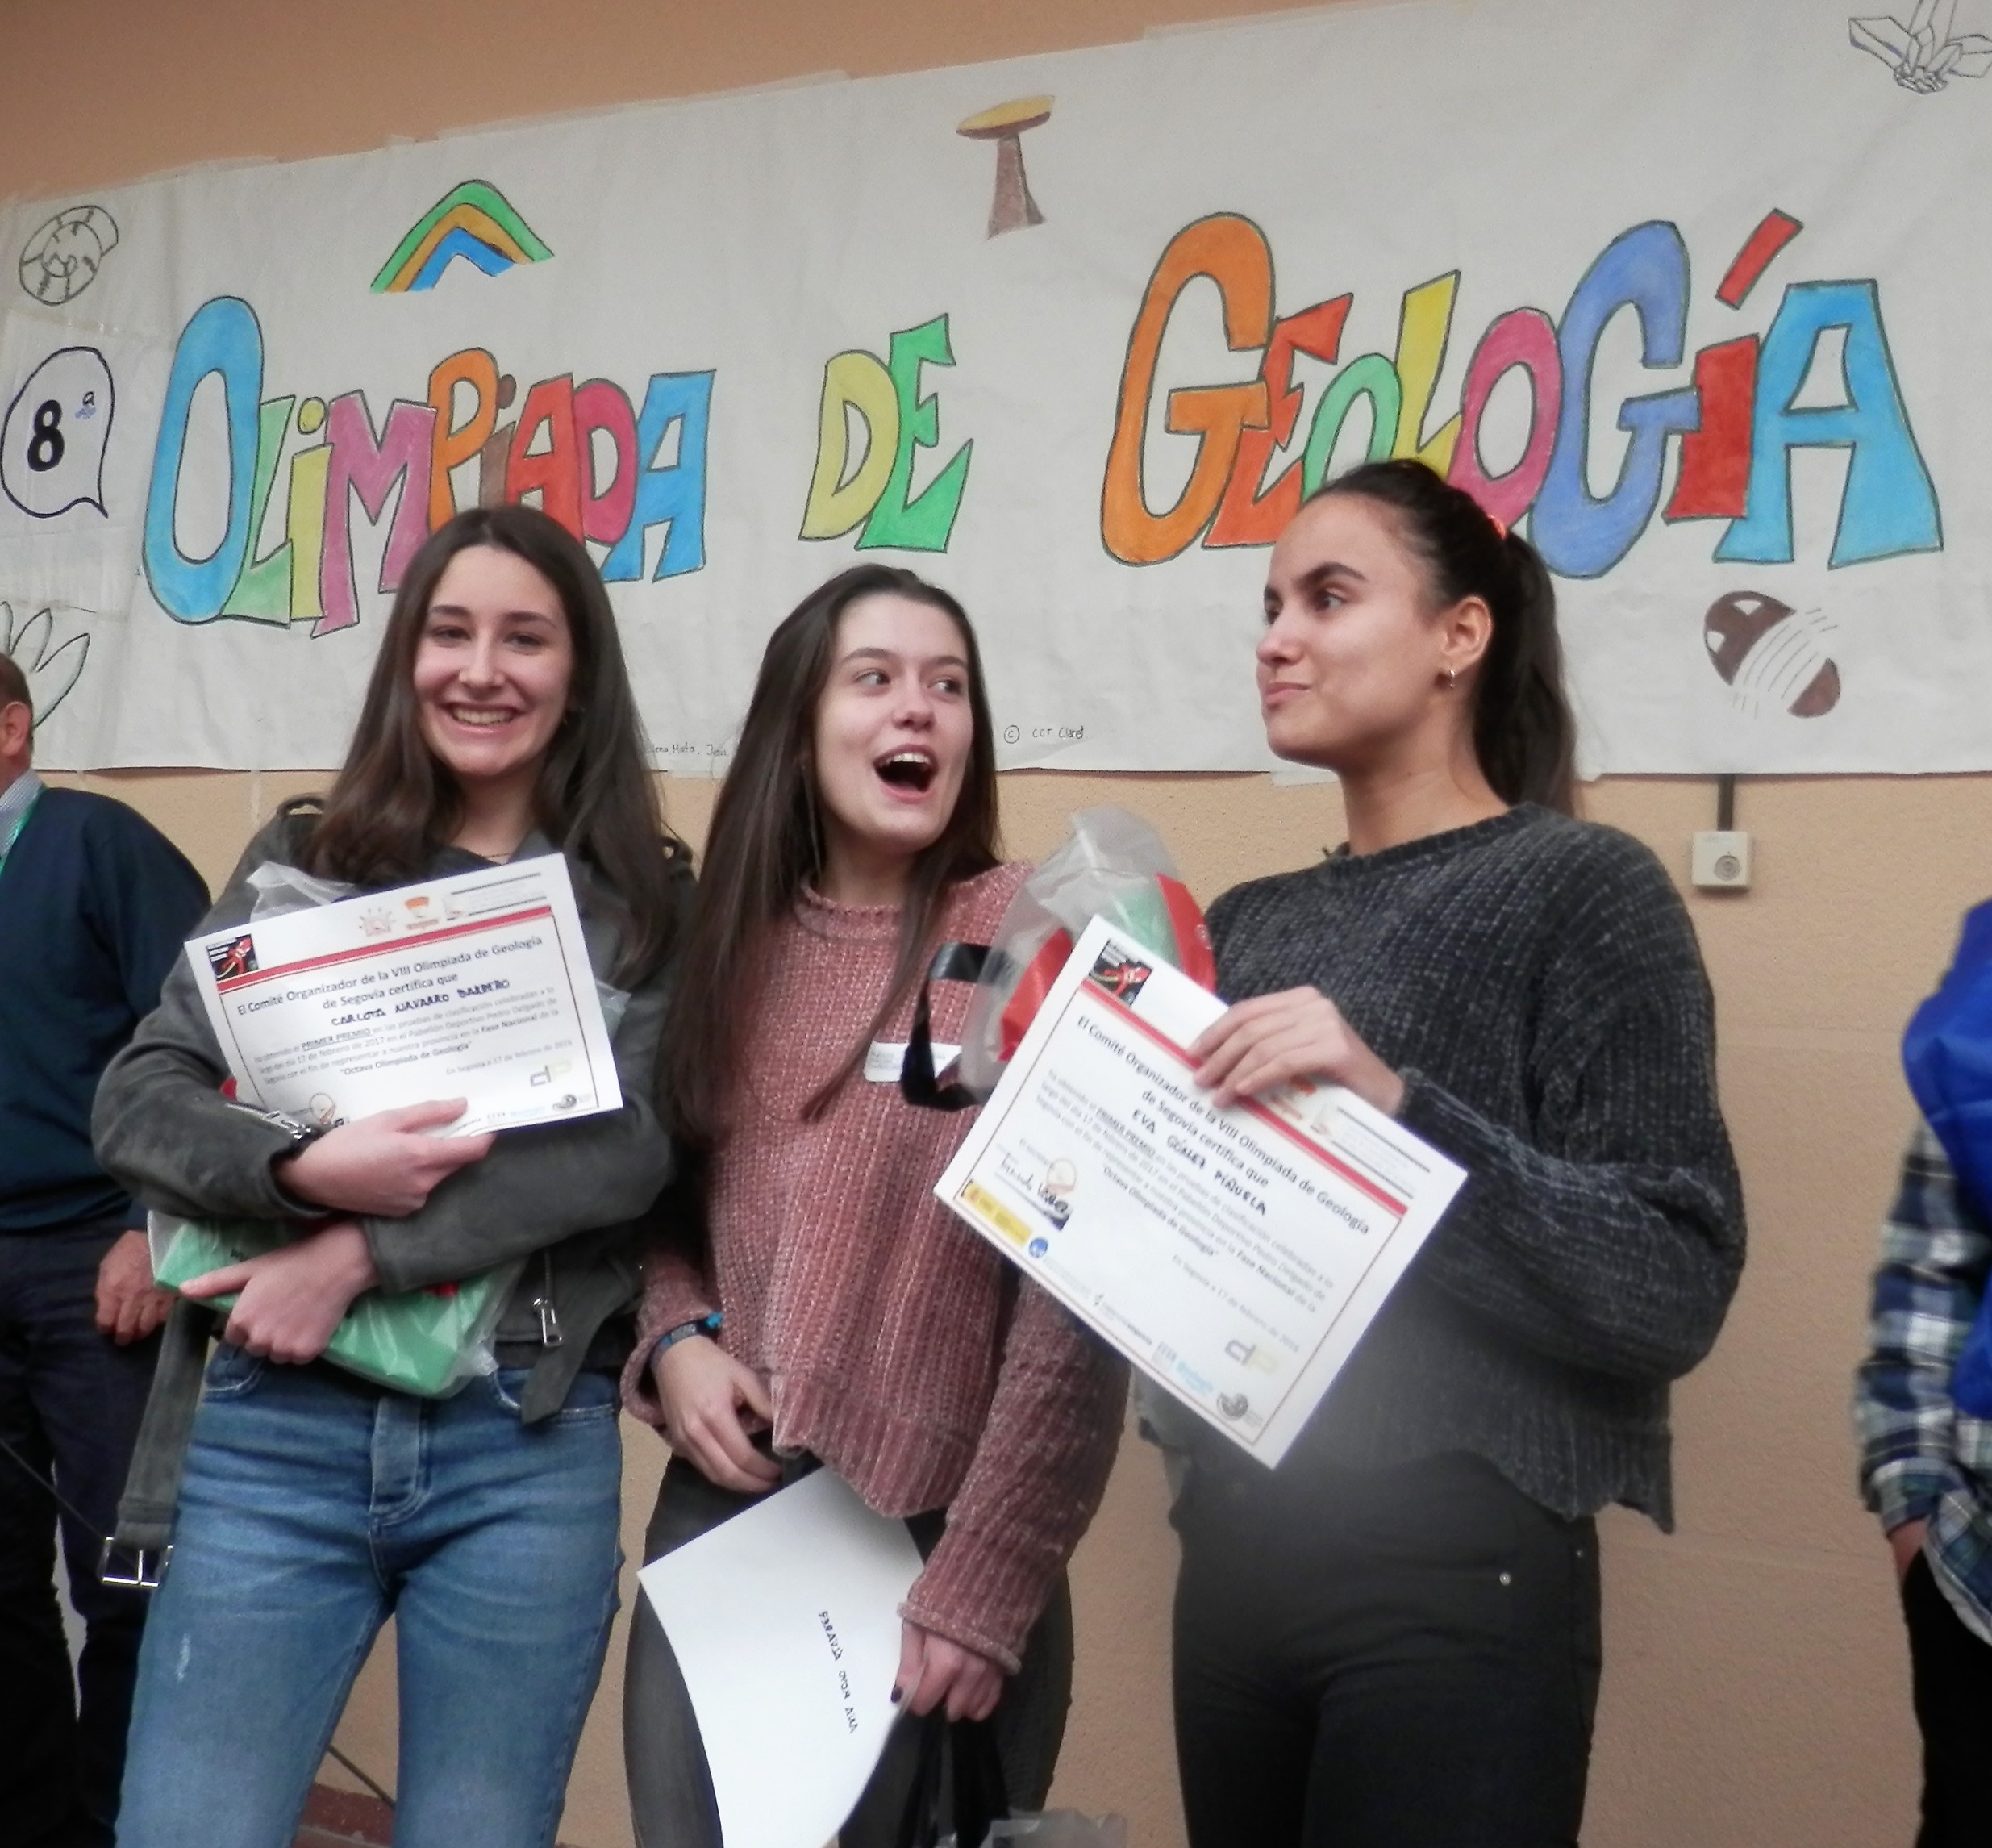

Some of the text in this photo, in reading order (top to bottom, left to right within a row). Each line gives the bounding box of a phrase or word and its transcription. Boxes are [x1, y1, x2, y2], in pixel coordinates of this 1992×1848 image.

[798, 313, 973, 552] DE
[1100, 209, 1944, 579] GEOLOGÍA
[235, 933, 544, 1016] El Comité Organizador de la VIII Olimpiada de Geología
[321, 972, 460, 1010] de Segovia certifica que
[330, 1007, 387, 1027] CARLOTA
[392, 991, 450, 1014] NAVARRO
[335, 1027, 372, 1043] PREMIO
[1075, 1014, 1373, 1238] El Comité Organizador de la VIII Olimpiada de Geología
[1129, 1107, 1160, 1135] EVA
[1140, 1087, 1270, 1191] de Segovia certifica que
